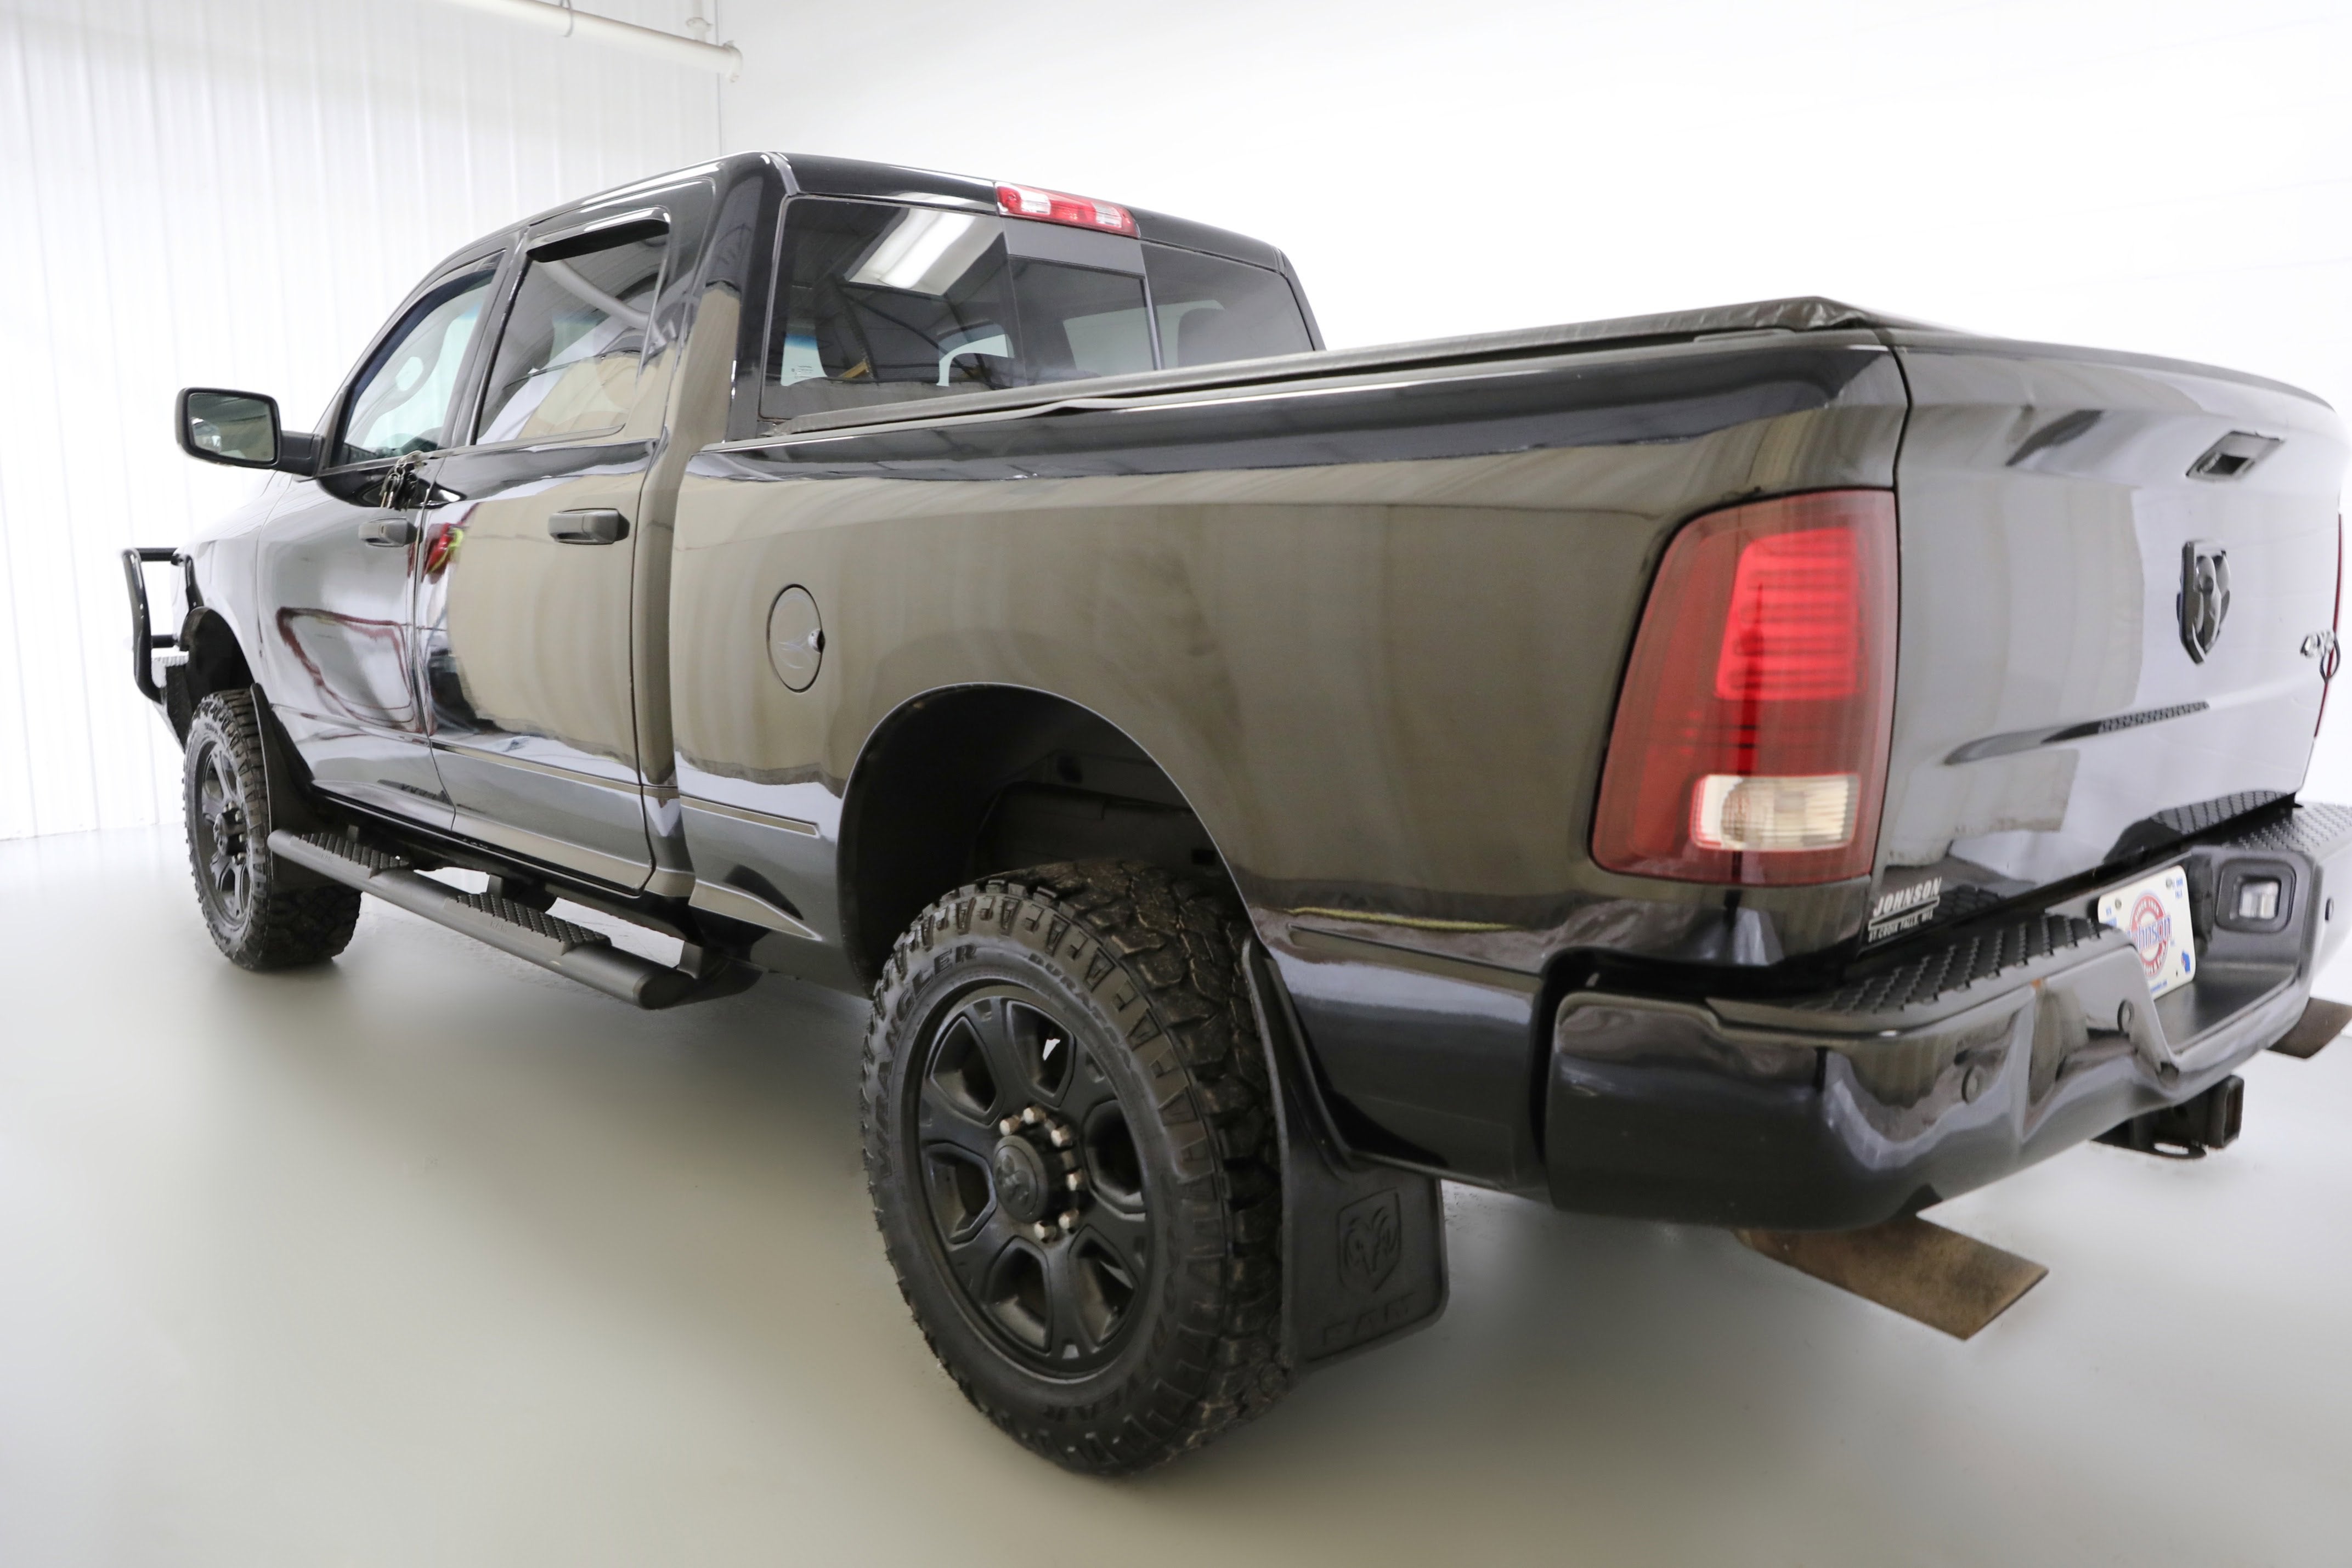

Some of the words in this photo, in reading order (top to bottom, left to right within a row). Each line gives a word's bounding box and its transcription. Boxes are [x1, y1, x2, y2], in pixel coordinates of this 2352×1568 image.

[1873, 876, 1942, 917] JOHNSON
[875, 943, 977, 1178] WRANGLER
[1028, 952, 1142, 1094] DURATRA
